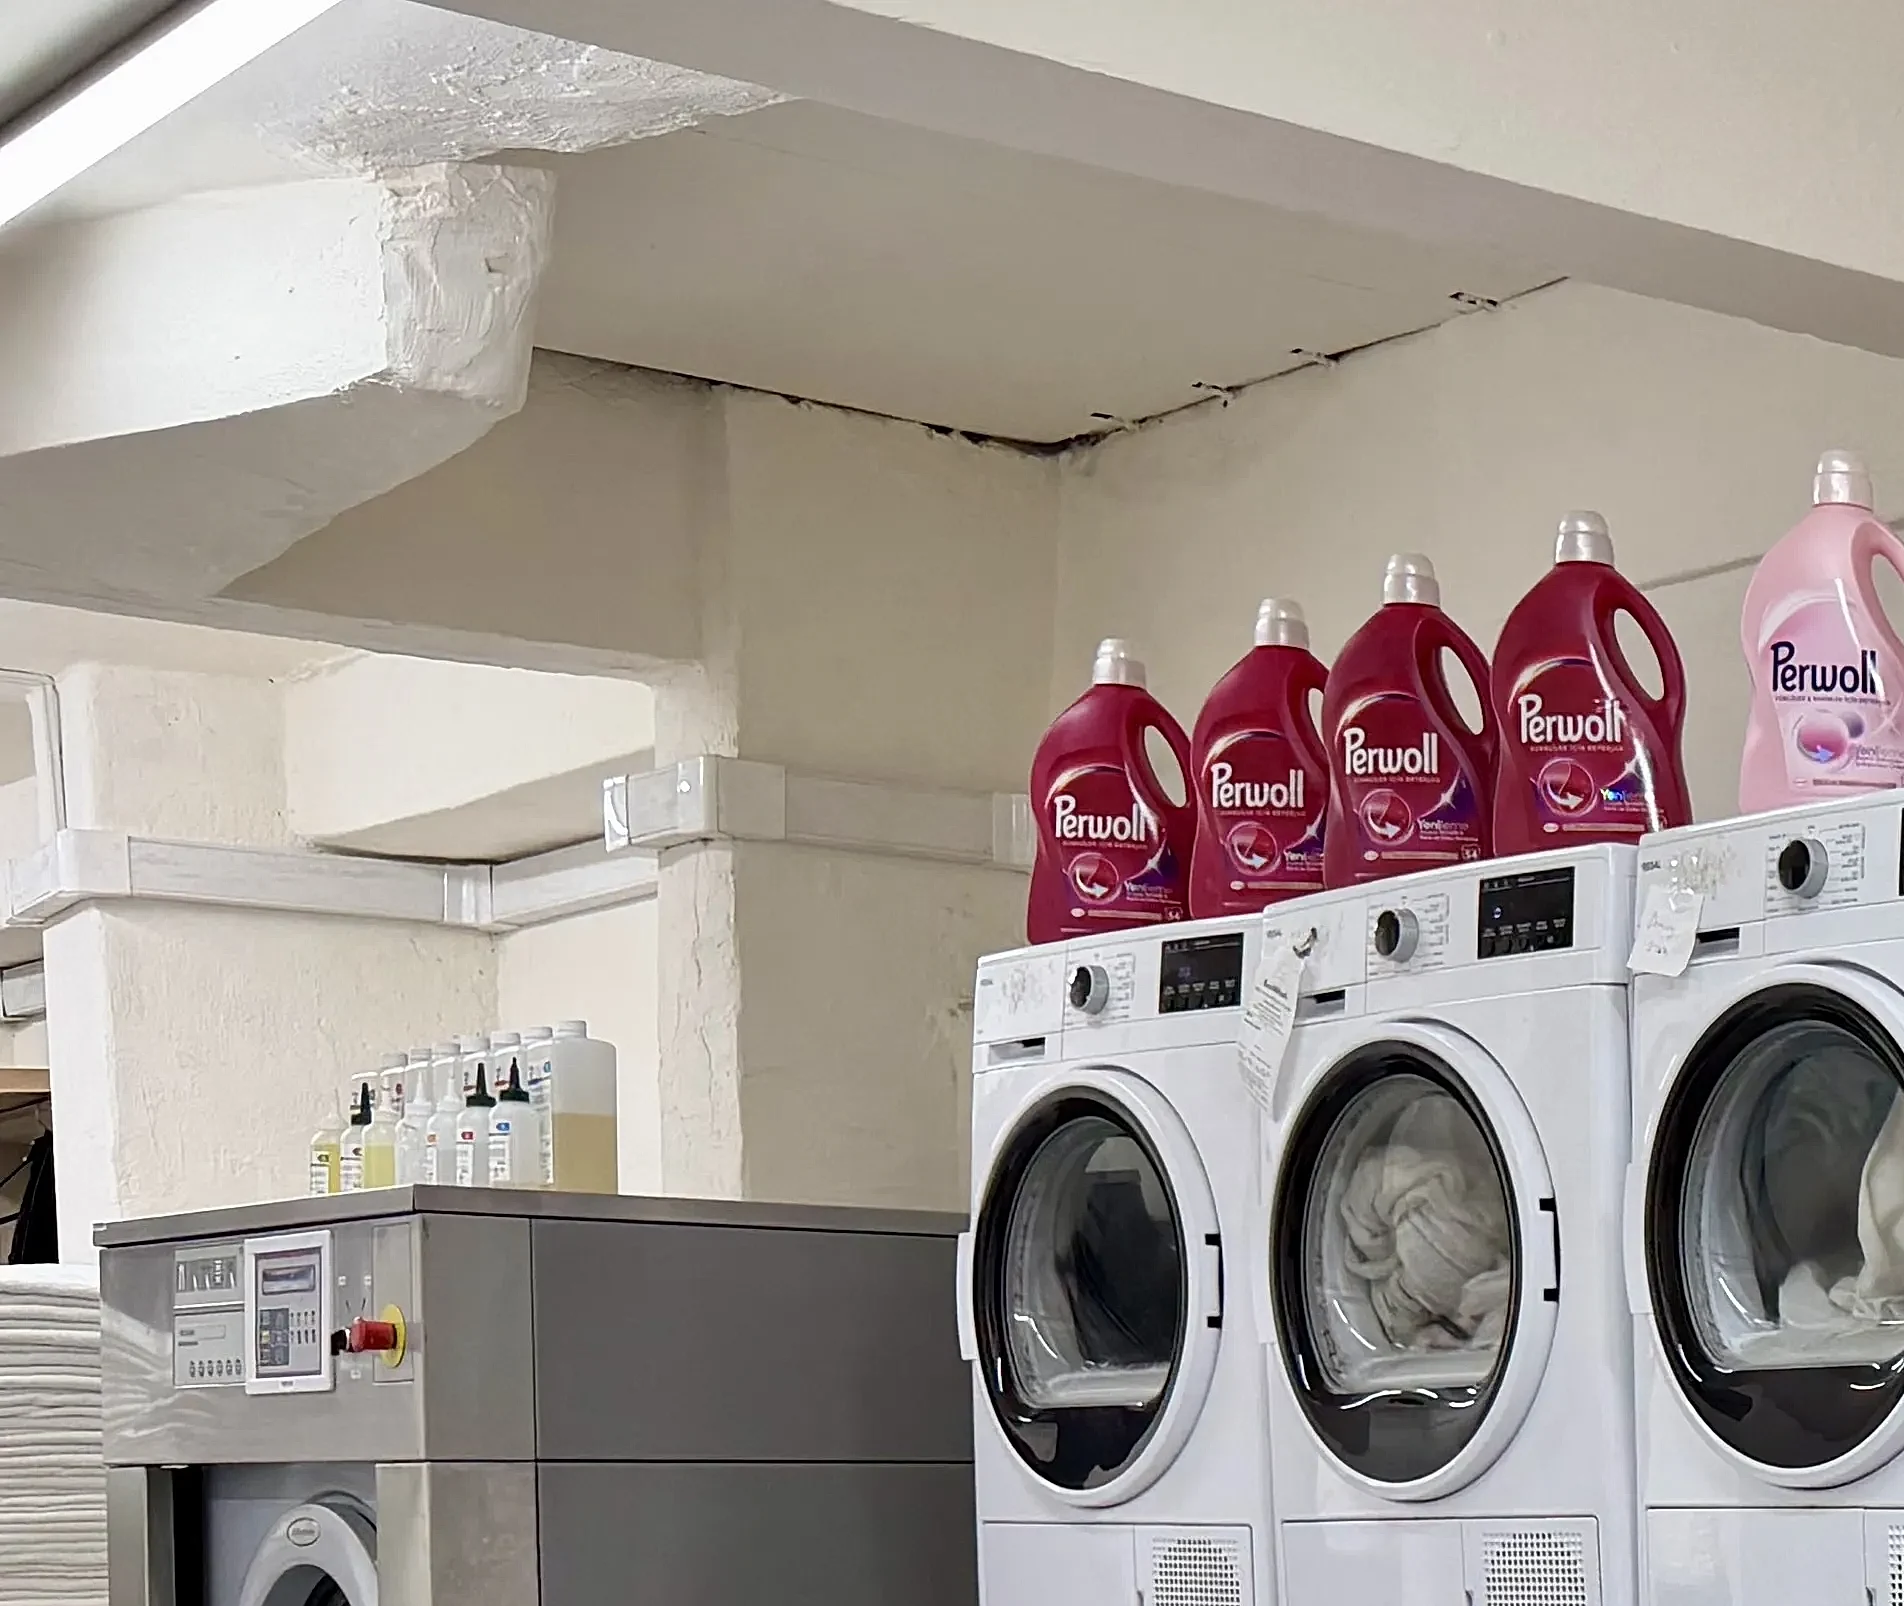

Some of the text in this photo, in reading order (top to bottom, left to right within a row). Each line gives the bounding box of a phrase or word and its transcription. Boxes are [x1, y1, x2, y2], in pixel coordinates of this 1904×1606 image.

[1771, 641, 1877, 694] Perwoll
[1518, 693, 1622, 744] Perwoll
[1343, 727, 1438, 775] Perwoll
[1211, 762, 1304, 808] Perwoll
[1054, 794, 1145, 842] Perwoll
